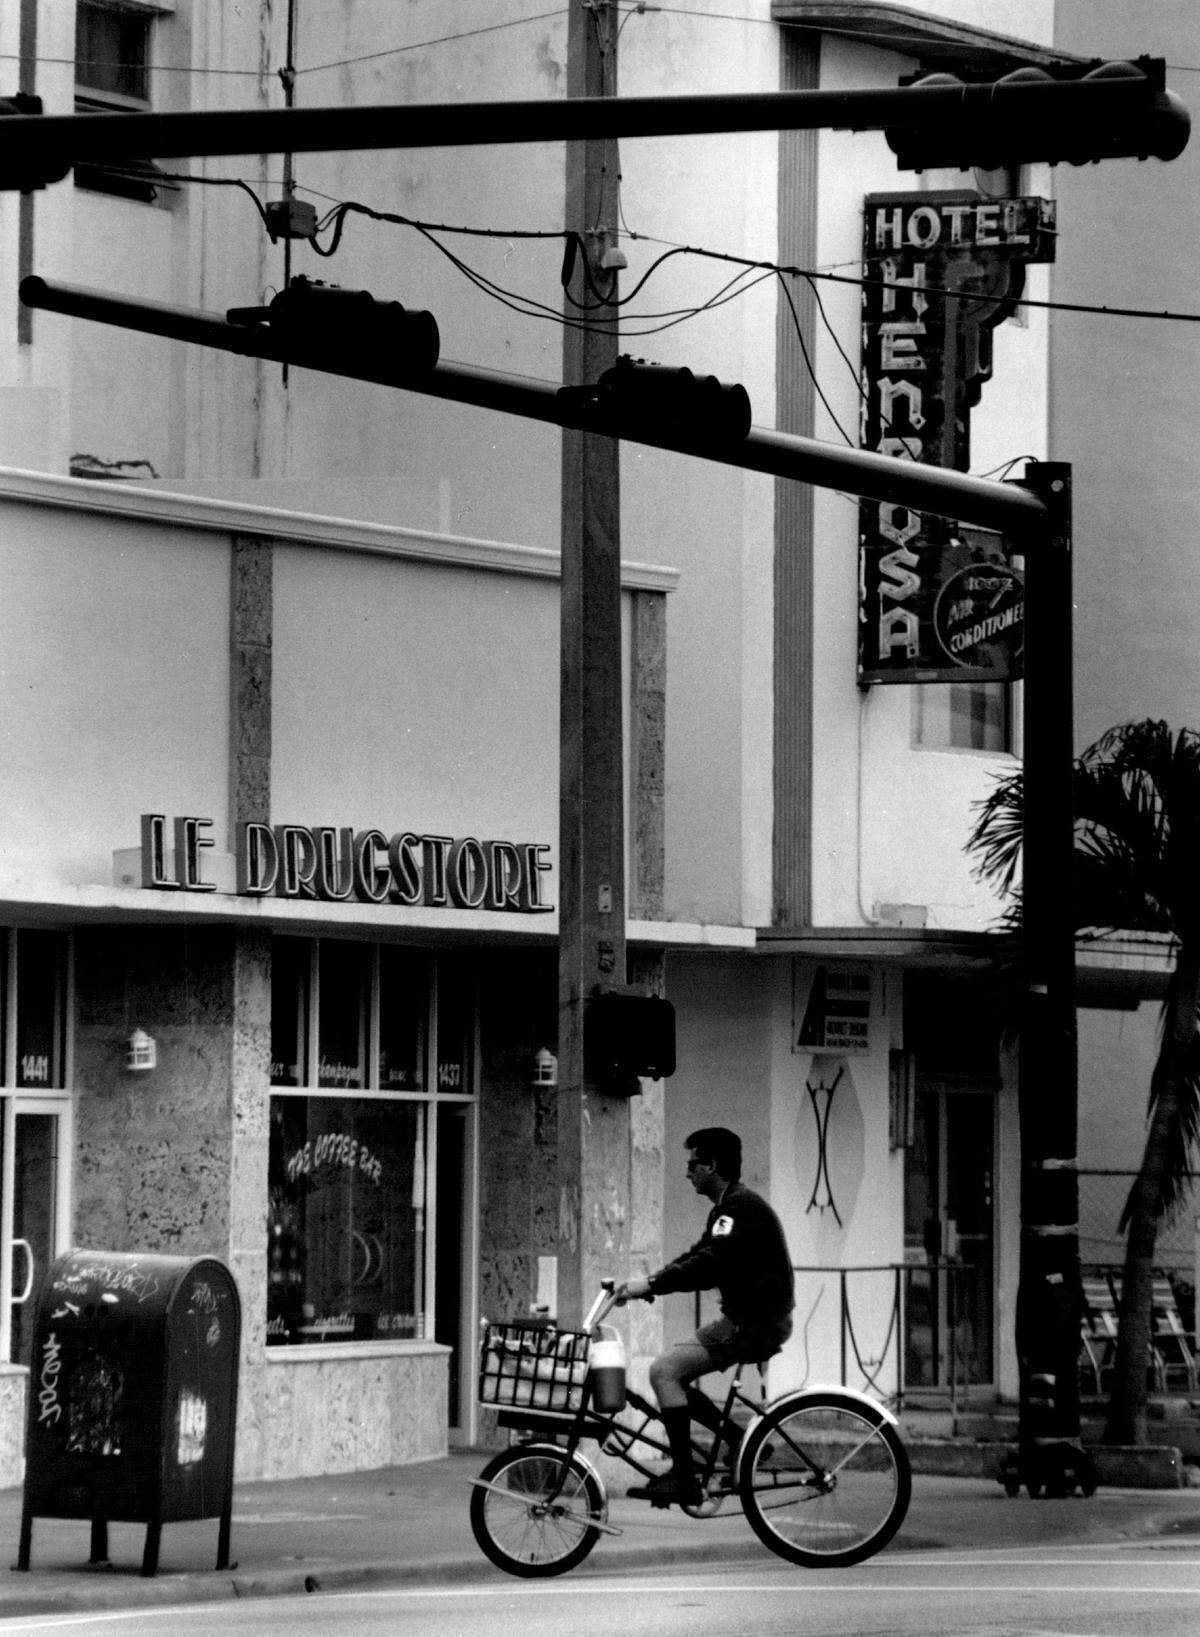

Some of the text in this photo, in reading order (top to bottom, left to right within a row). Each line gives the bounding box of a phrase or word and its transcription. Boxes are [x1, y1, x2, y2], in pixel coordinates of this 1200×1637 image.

[875, 205, 1030, 249] HOTEL
[141, 814, 554, 914] LE DRUGSTORE
[21, 1055, 48, 1081] 1441
